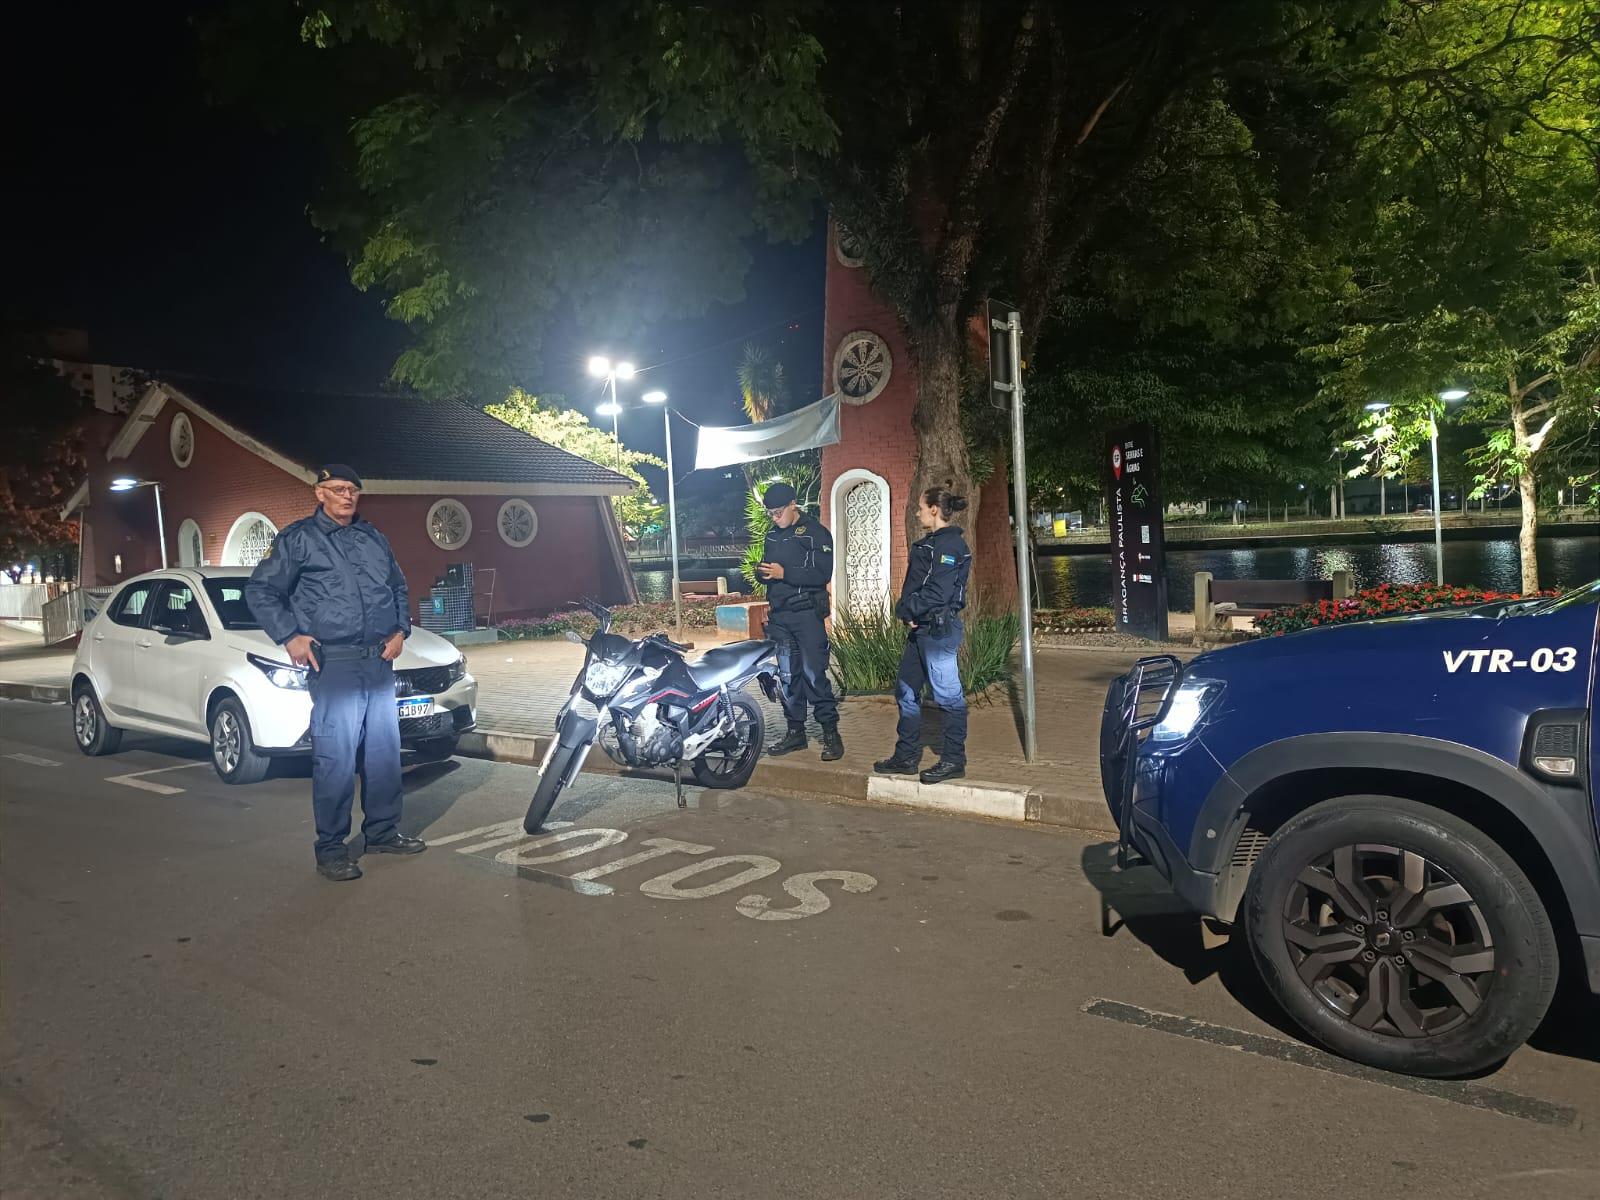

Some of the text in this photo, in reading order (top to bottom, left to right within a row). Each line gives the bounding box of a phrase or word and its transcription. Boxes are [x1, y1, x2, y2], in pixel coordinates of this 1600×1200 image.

[1116, 487, 1129, 624] BRAGANÇA PAULISTA
[1443, 647, 1577, 673] VTR-03
[425, 817, 878, 921] MOTOS
